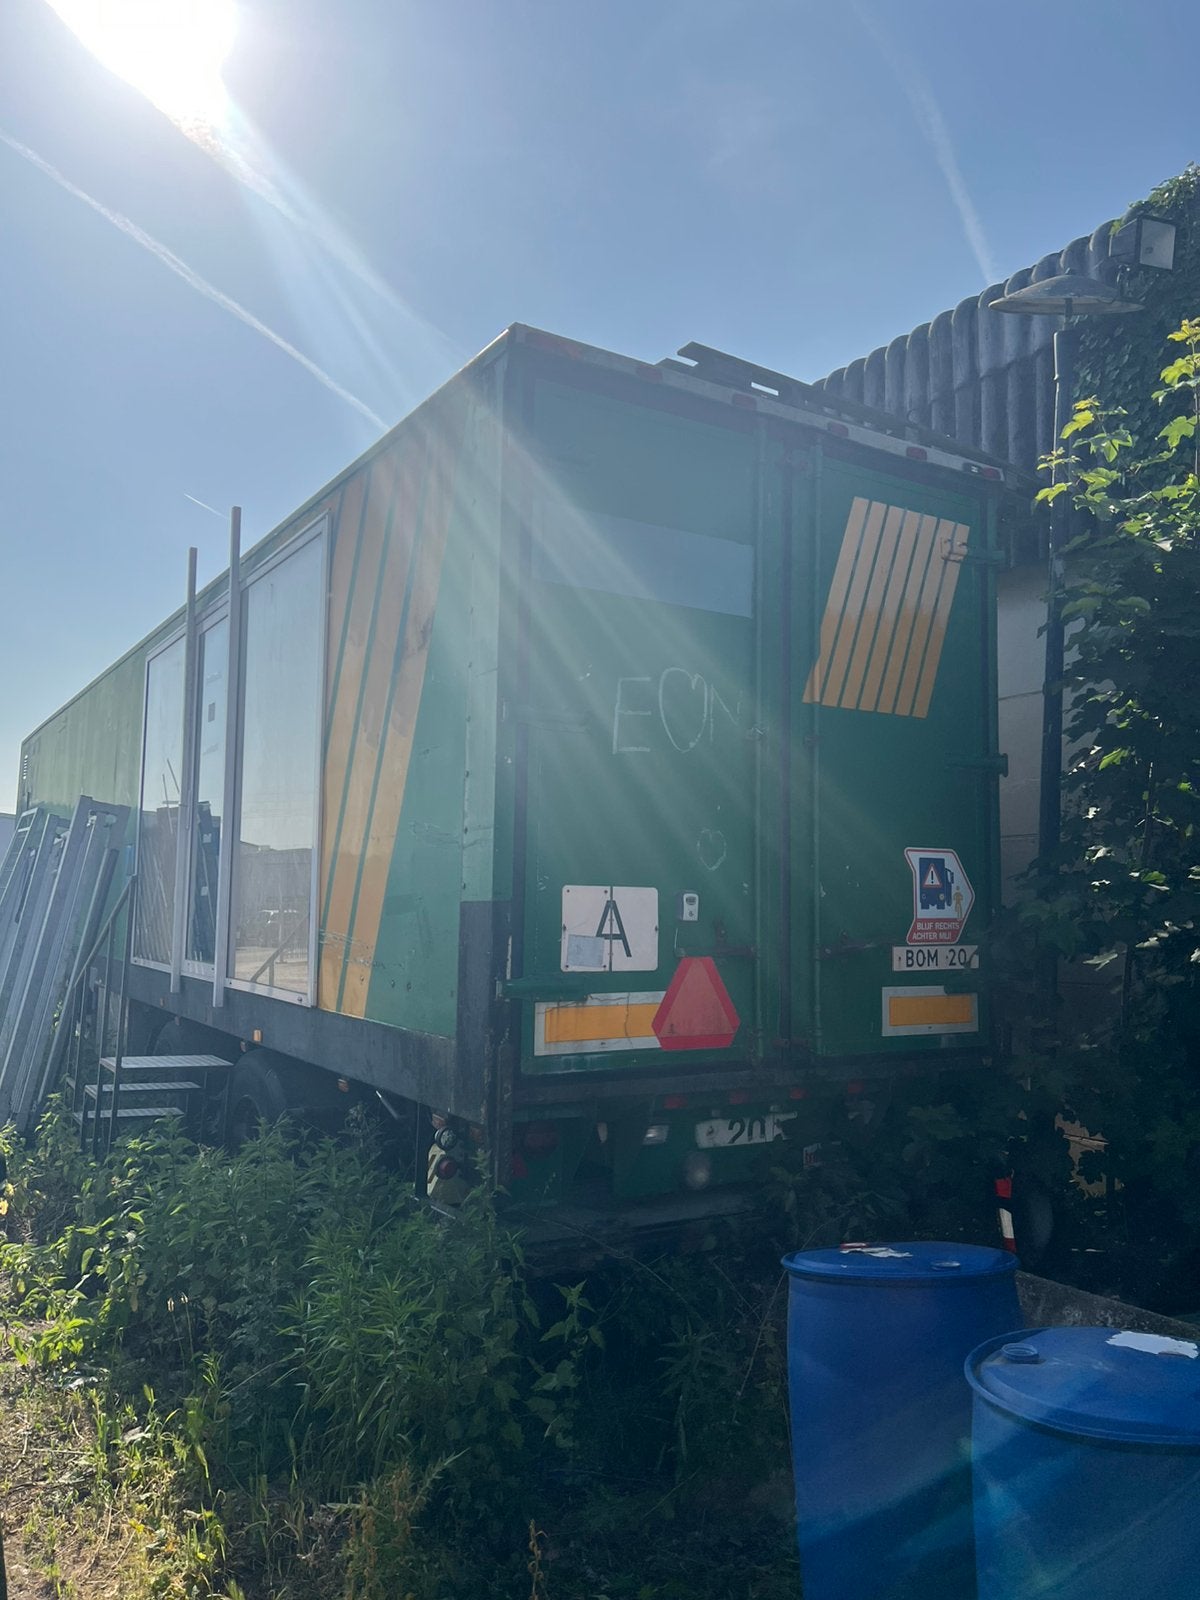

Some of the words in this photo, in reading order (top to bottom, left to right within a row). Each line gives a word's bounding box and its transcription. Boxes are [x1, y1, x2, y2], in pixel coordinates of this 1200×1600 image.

[597, 900, 632, 957] A
[935, 921, 960, 931] RECHTS
[912, 931, 938, 940] ACHTER
[906, 949, 939, 968] BOM
